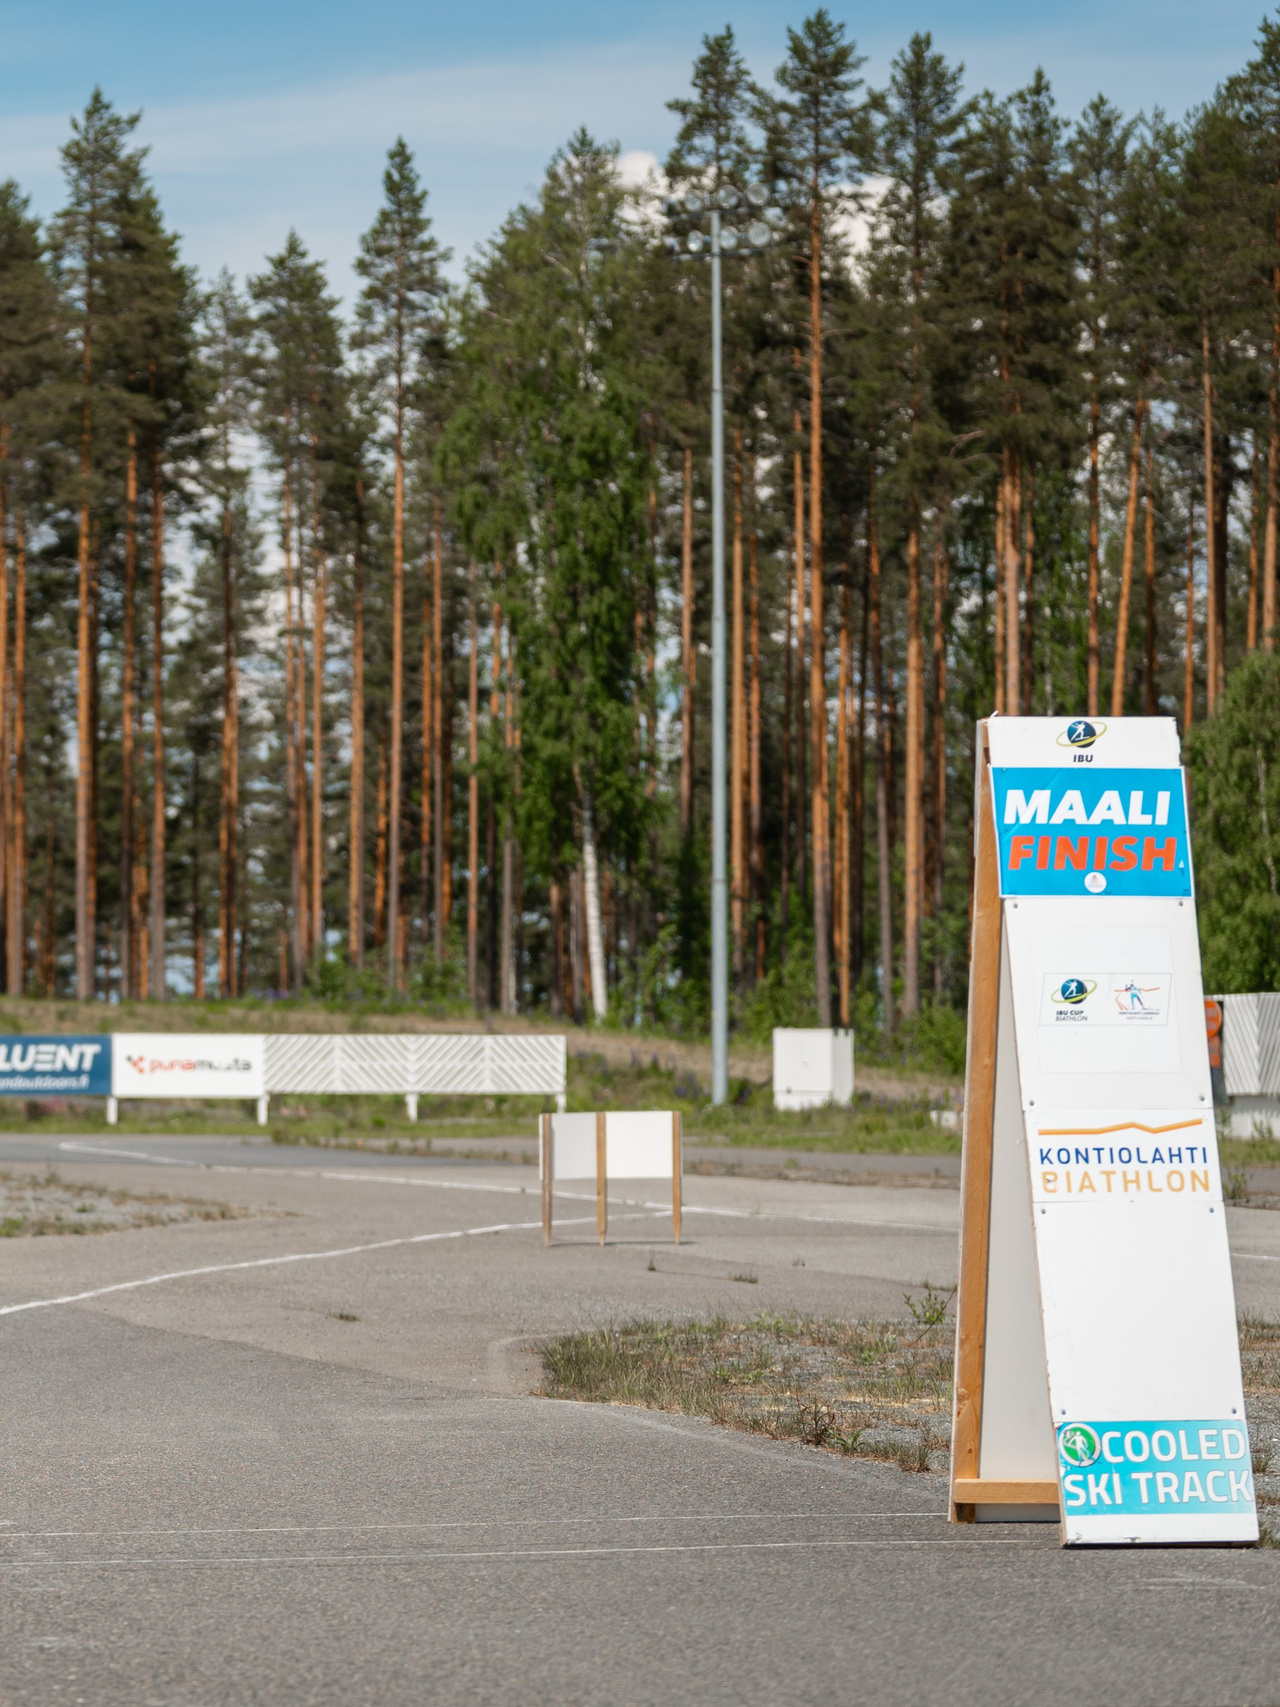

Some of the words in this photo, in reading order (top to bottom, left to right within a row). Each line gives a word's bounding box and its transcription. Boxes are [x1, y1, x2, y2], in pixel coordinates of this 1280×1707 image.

[1073, 754, 1093, 763] IBU
[1003, 789, 1171, 825] MAALI
[1008, 835, 1177, 871] FINISH
[1039, 1147, 1208, 1165] KONTIOLAHTI
[1042, 1169, 1210, 1194] BIATHLON
[1101, 1428, 1246, 1464] COOLED
[1064, 1473, 1123, 1507] SKI
[1131, 1469, 1254, 1505] TRACK
